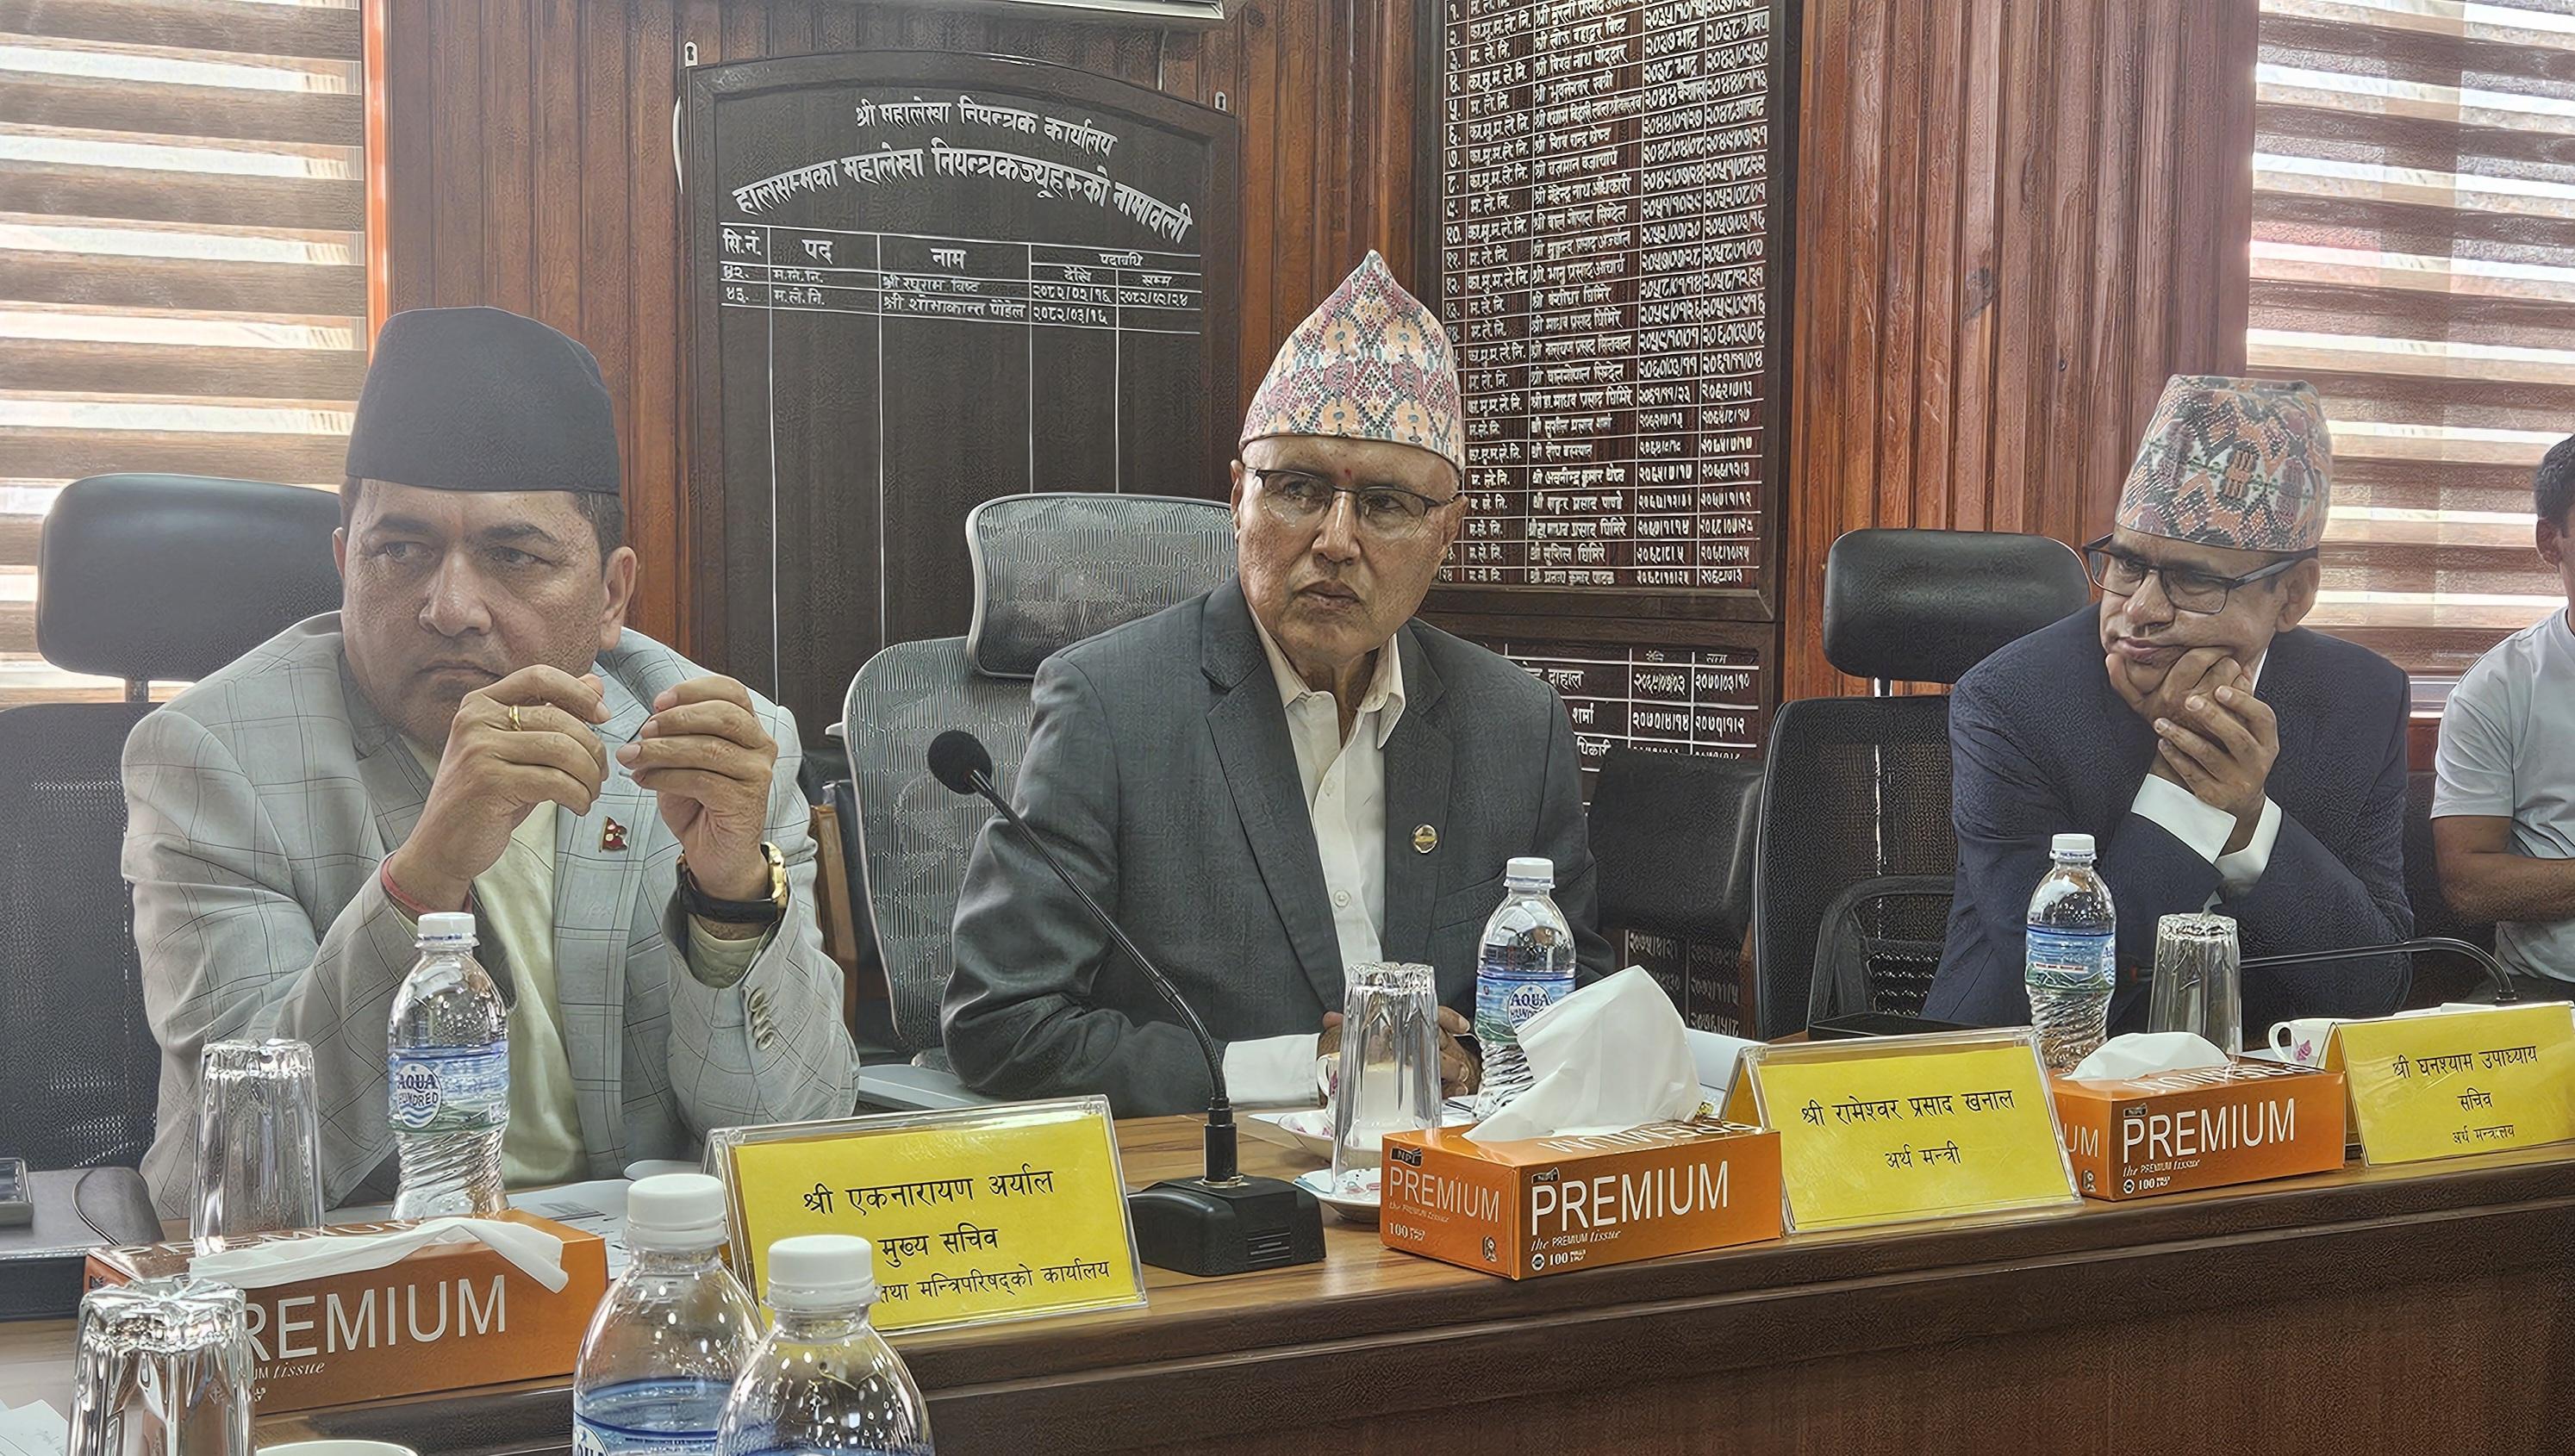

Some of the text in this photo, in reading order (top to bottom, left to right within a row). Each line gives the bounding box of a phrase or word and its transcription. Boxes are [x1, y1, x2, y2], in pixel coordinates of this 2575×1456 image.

[1537, 5, 1549, 26] श्री
[1535, 32, 1547, 51] श्री
[1535, 57, 1547, 77] श्री
[1535, 84, 1546, 103] श्री
[856, 96, 1118, 156] श्री महालेखा नियन्त्रक कार्यालय
[1535, 109, 1546, 128] श्री
[1535, 135, 1545, 153] श्री
[1535, 160, 1545, 179] श्री
[733, 160, 838, 215] हालसम्मका
[841, 141, 924, 184] महालेखा
[1113, 182, 1193, 243] नामावली
[1535, 185, 1545, 205] श्री
[1534, 215, 1545, 231] श्री
[801, 240, 832, 264] पद
[930, 248, 967, 270] नाम
[883, 293, 904, 310] श्री
[1533, 291, 1543, 309] श्री
[1532, 314, 1542, 334] श्री
[1549, 669, 1584, 690] दाहाल
[1510, 993, 1550, 1009] AQUA
[2393, 1046, 2537, 1079] श्री घनश्याम उपाध्याय
[397, 1074, 438, 1093] AQUA
[1801, 1089, 2017, 1126] श्री रामेश्वर प्रसाद खनाल
[2457, 1087, 2493, 1111] सचिव
[2123, 1098, 2297, 1164] PREMIUM
[1885, 1141, 1961, 1169] अर्थ मन्त्री
[803, 1162, 1054, 1217] श्री एकनारायण अर्याल
[2139, 1179, 2154, 1190] 100
[1389, 1167, 1499, 1223] PREMIUM
[1531, 1160, 1728, 1235] PREMIUM
[1389, 1223, 1408, 1238] 100
[1552, 1234, 1587, 1247] PREMIUM
[877, 1223, 1000, 1267] मुख्य सचिव
[1550, 1253, 1568, 1266] 100
[1041, 1260, 1109, 1284] कार्यालय
[245, 1275, 507, 1361] REMIUM
